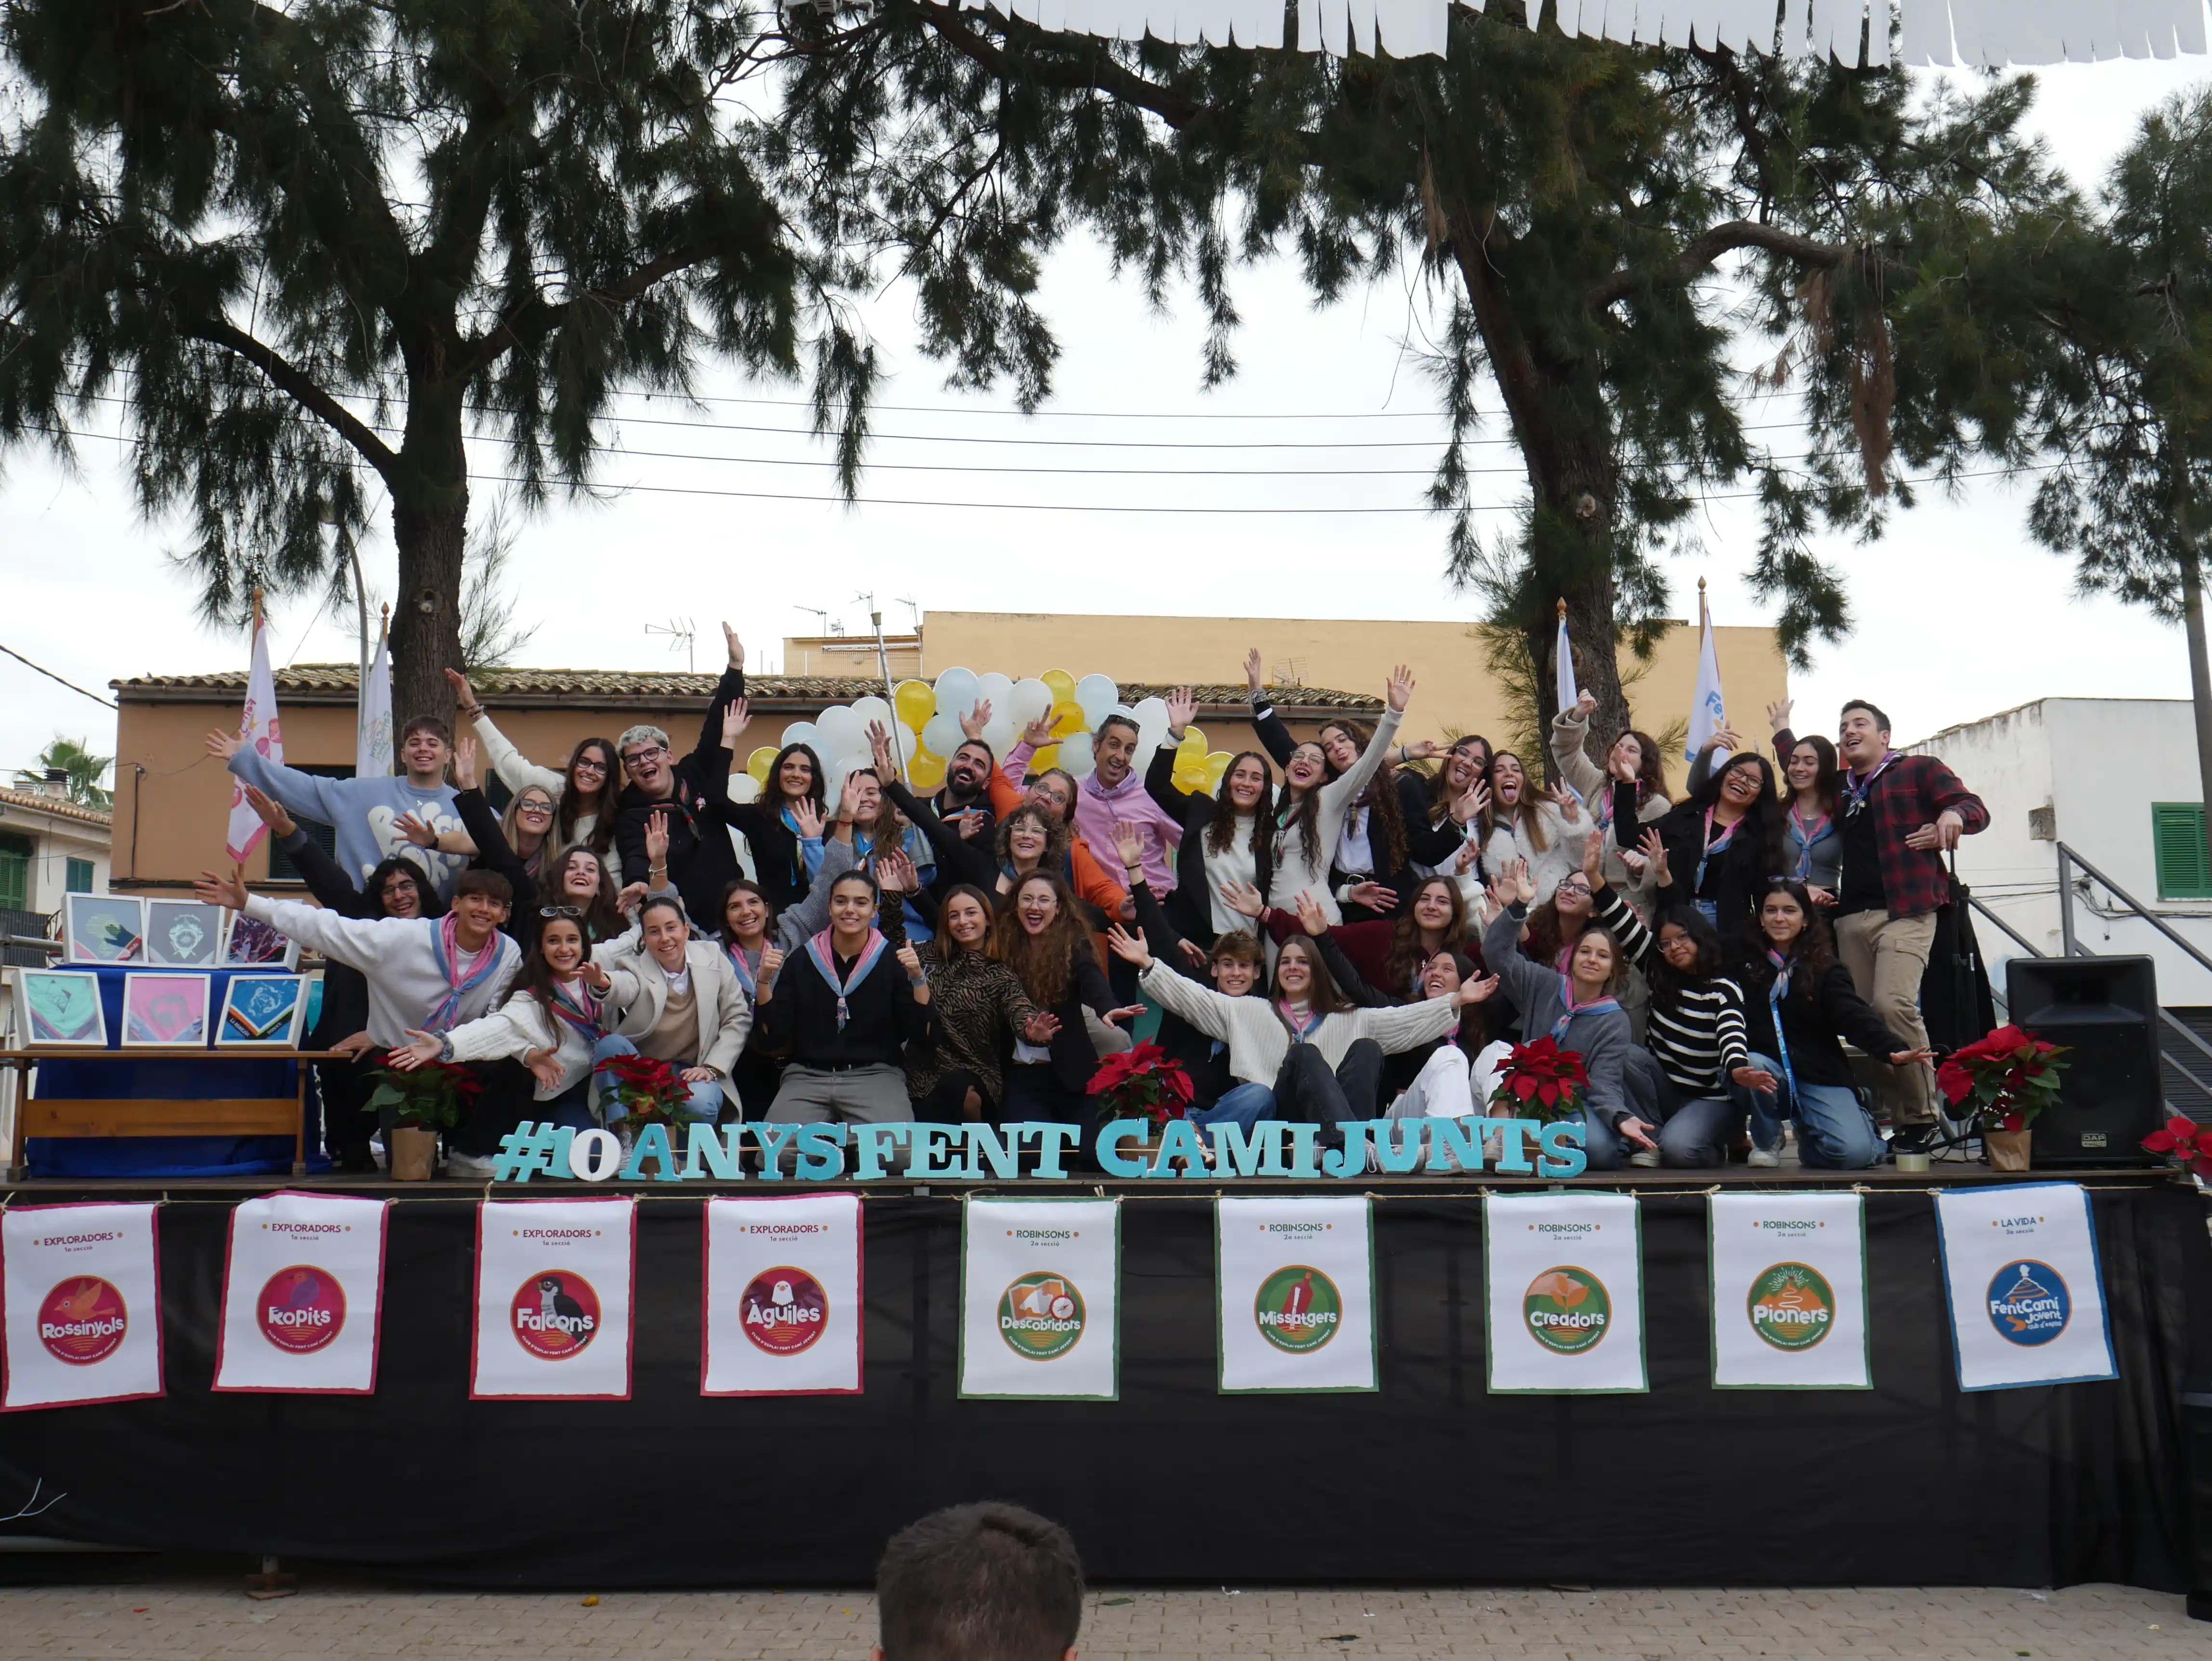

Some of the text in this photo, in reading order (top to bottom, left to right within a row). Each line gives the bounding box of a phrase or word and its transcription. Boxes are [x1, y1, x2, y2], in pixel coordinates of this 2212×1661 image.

[491, 1116, 1587, 1182] #10 ANYS FENT CAMI JUNTS
[272, 1224, 341, 1233] EXPLORADORS
[1539, 1224, 1592, 1232] ROBINSONS
[2014, 1217, 2037, 1226] VIDA
[750, 1225, 818, 1234] EXPLORADORS
[1016, 1230, 1070, 1239] ROBINSONS
[44, 1232, 114, 1246] EXPLORADORS
[517, 1308, 593, 1332] Falcons
[746, 1298, 820, 1329] Àguiles
[1259, 1311, 1337, 1328] Missatgers
[1530, 1311, 1605, 1327] Creadors
[1753, 1305, 1828, 1324] Pioners
[2025, 1311, 2062, 1324] Jovent
[42, 1317, 124, 1339] Rossinyols
[1002, 1316, 1081, 1331] Descobridors
